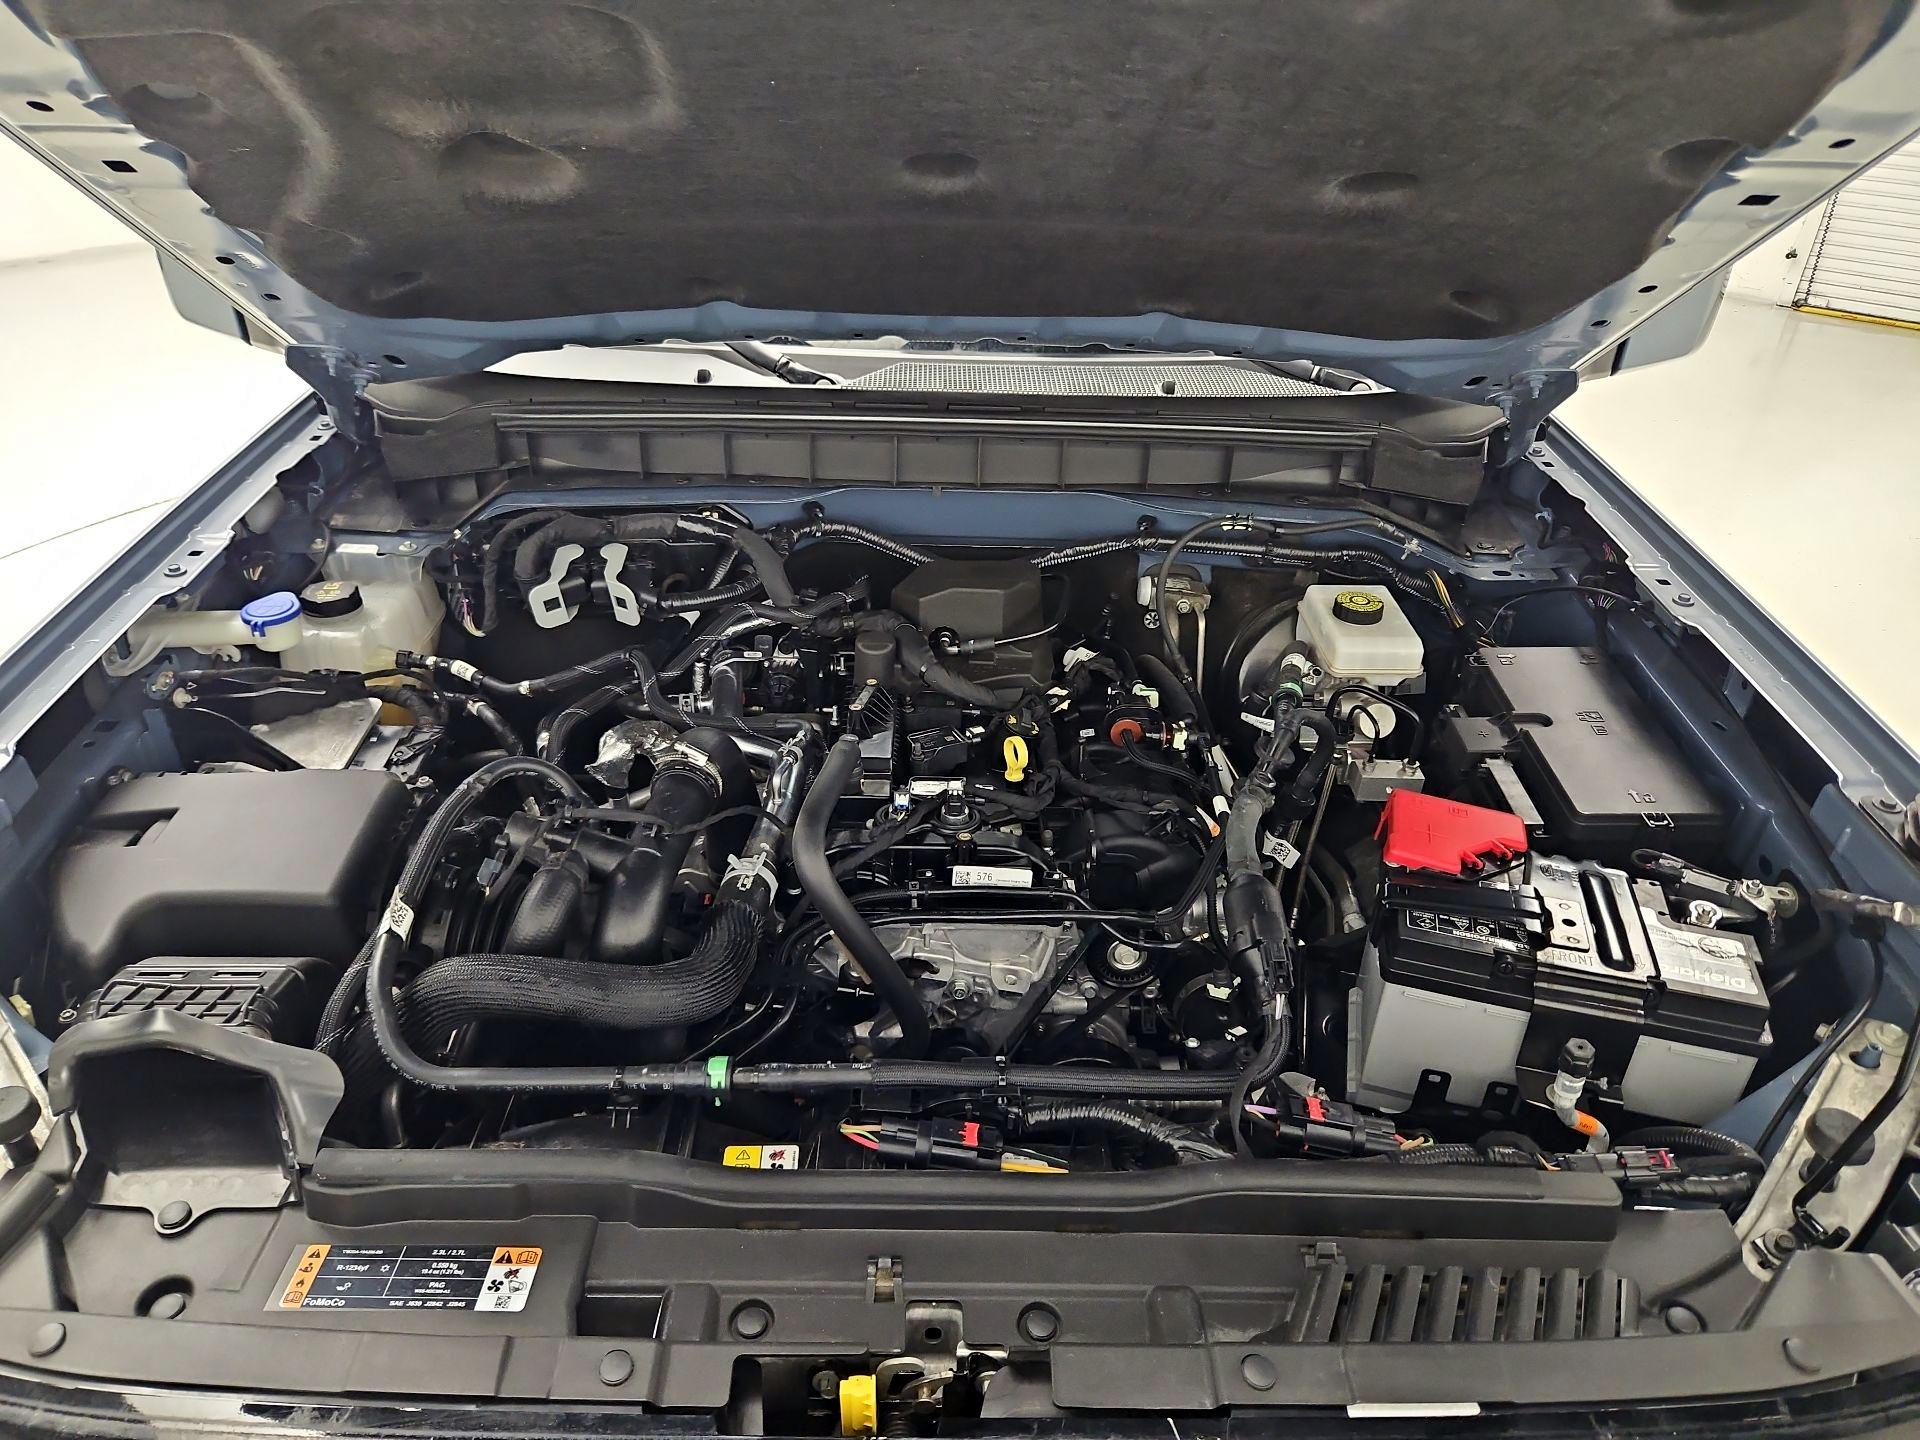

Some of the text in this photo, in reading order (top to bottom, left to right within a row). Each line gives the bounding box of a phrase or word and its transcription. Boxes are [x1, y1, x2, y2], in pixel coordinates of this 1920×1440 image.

[976, 871, 993, 882] 576
[1551, 949, 1594, 967] FRONT
[336, 1264, 370, 1272] R-1234yf
[449, 1262, 459, 1270] kg
[302, 1297, 346, 1307] FoMoCo
